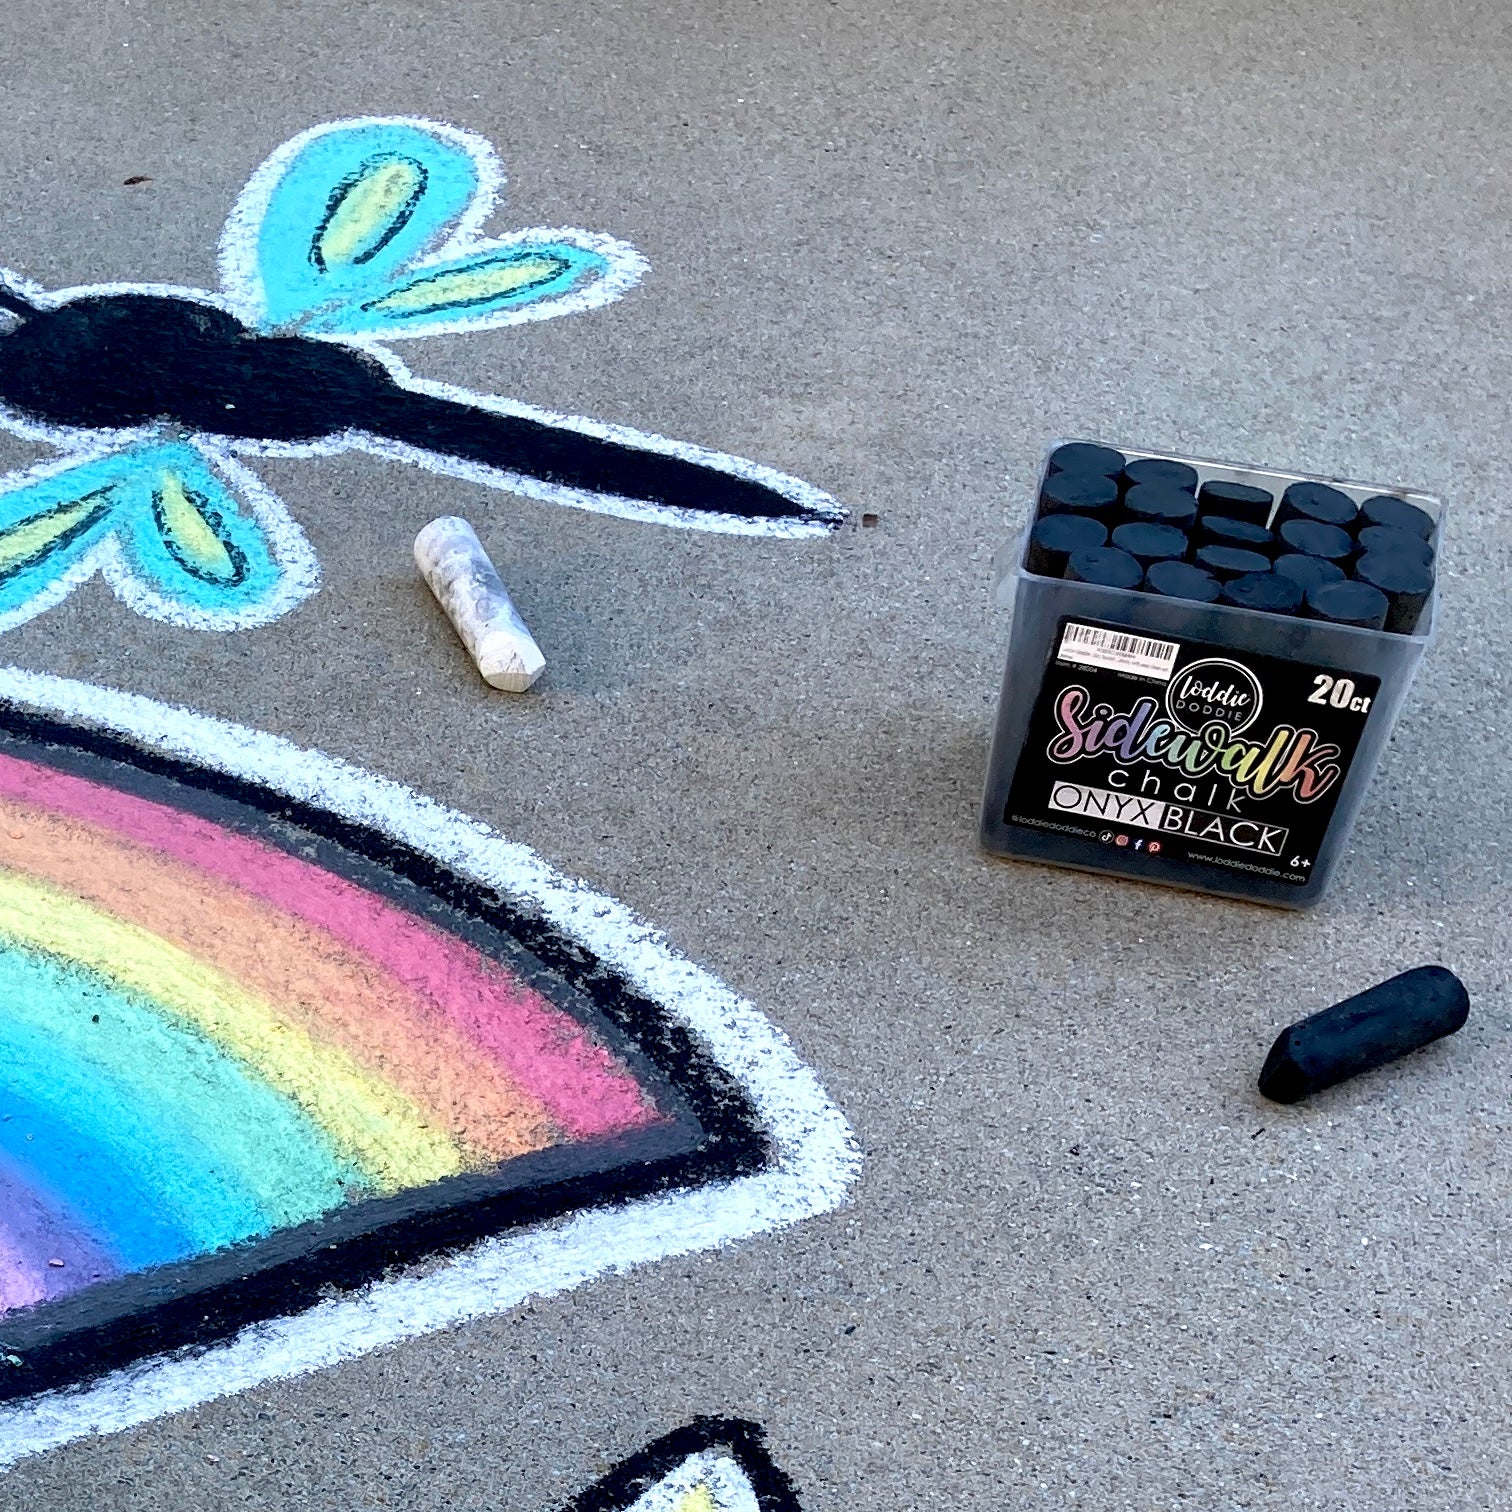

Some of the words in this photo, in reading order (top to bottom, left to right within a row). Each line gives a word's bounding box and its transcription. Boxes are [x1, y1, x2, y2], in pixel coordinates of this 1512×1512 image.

[1176, 700, 1243, 721] DODDIE
[1307, 674, 1371, 713] 20ct
[1051, 689, 1337, 800] Sidewalk
[1108, 769, 1246, 813] chalk
[1054, 785, 1155, 826] ONYX
[1164, 806, 1282, 853] BLACK
[1290, 855, 1311, 868] 6+
